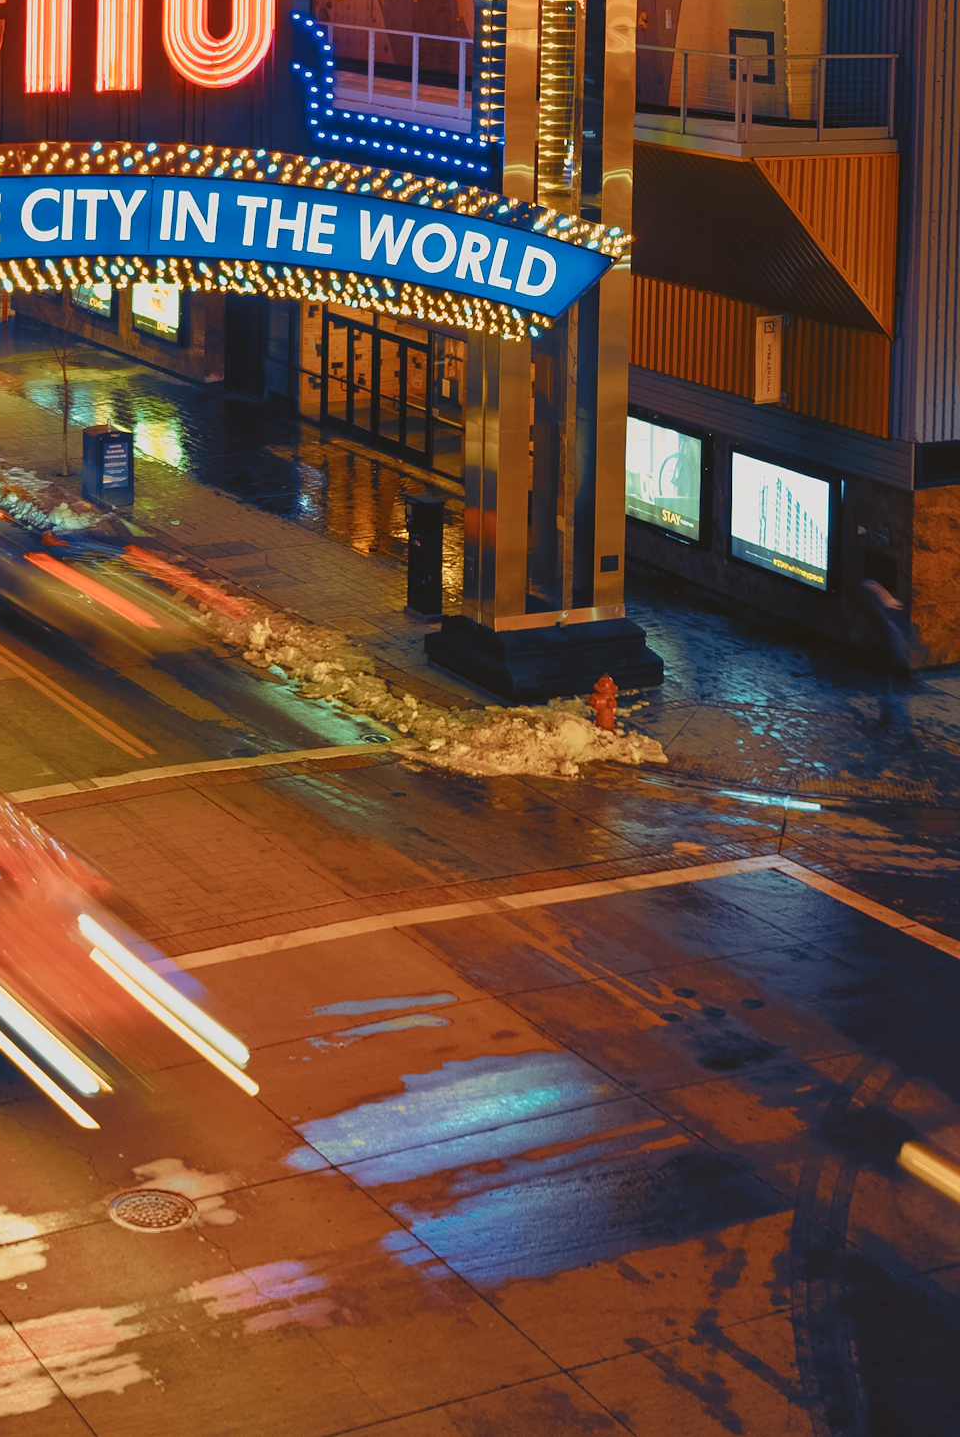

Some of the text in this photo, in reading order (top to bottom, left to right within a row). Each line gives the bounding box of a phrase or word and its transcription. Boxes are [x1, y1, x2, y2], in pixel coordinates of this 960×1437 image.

[20, 188, 147, 242] CITY
[159, 189, 220, 244] IN
[236, 195, 338, 255] THE
[358, 209, 557, 298] WORLD
[661, 509, 681, 526] STAY
